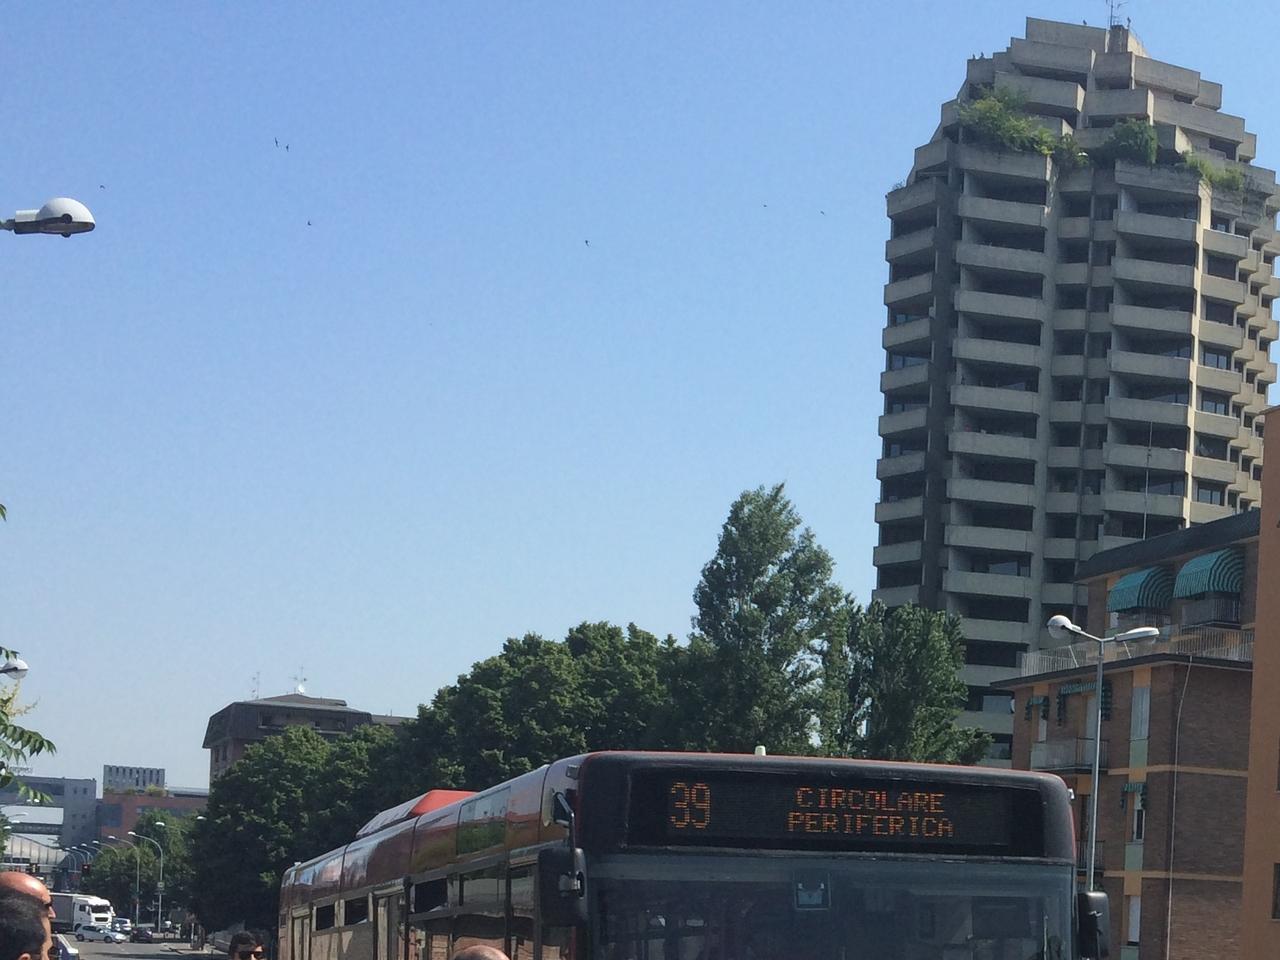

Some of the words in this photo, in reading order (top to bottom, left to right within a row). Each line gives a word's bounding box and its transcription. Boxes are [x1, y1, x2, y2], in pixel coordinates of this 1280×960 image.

[670, 782, 711, 829] 39
[796, 787, 945, 813] CIRCOLARE
[788, 812, 954, 837] PERIFERICA
